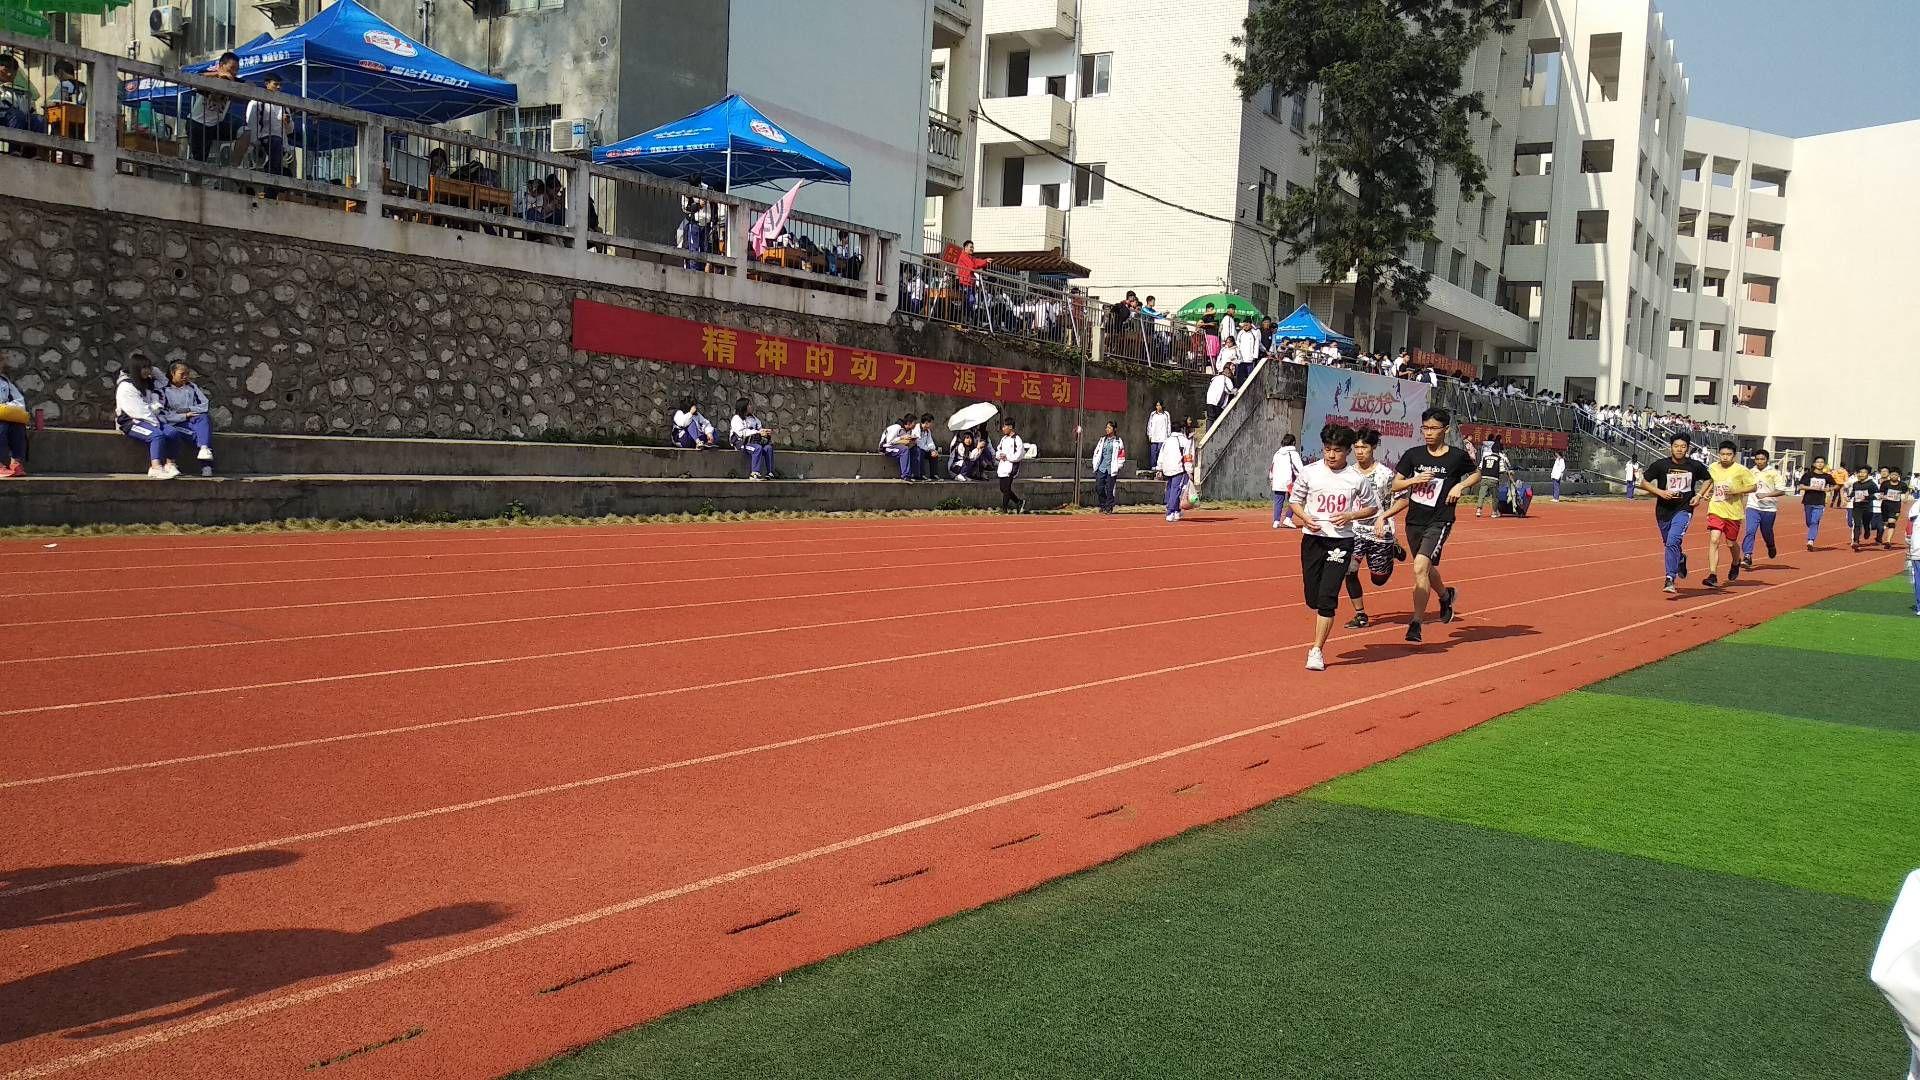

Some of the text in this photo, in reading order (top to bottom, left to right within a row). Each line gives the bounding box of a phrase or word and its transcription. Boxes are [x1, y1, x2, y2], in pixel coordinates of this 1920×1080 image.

[702, 326, 1071, 403] 精神的动力 源于运动
[1432, 465, 1440, 473] do
[1670, 476, 1689, 490] 271
[1317, 493, 1347, 513] 269
